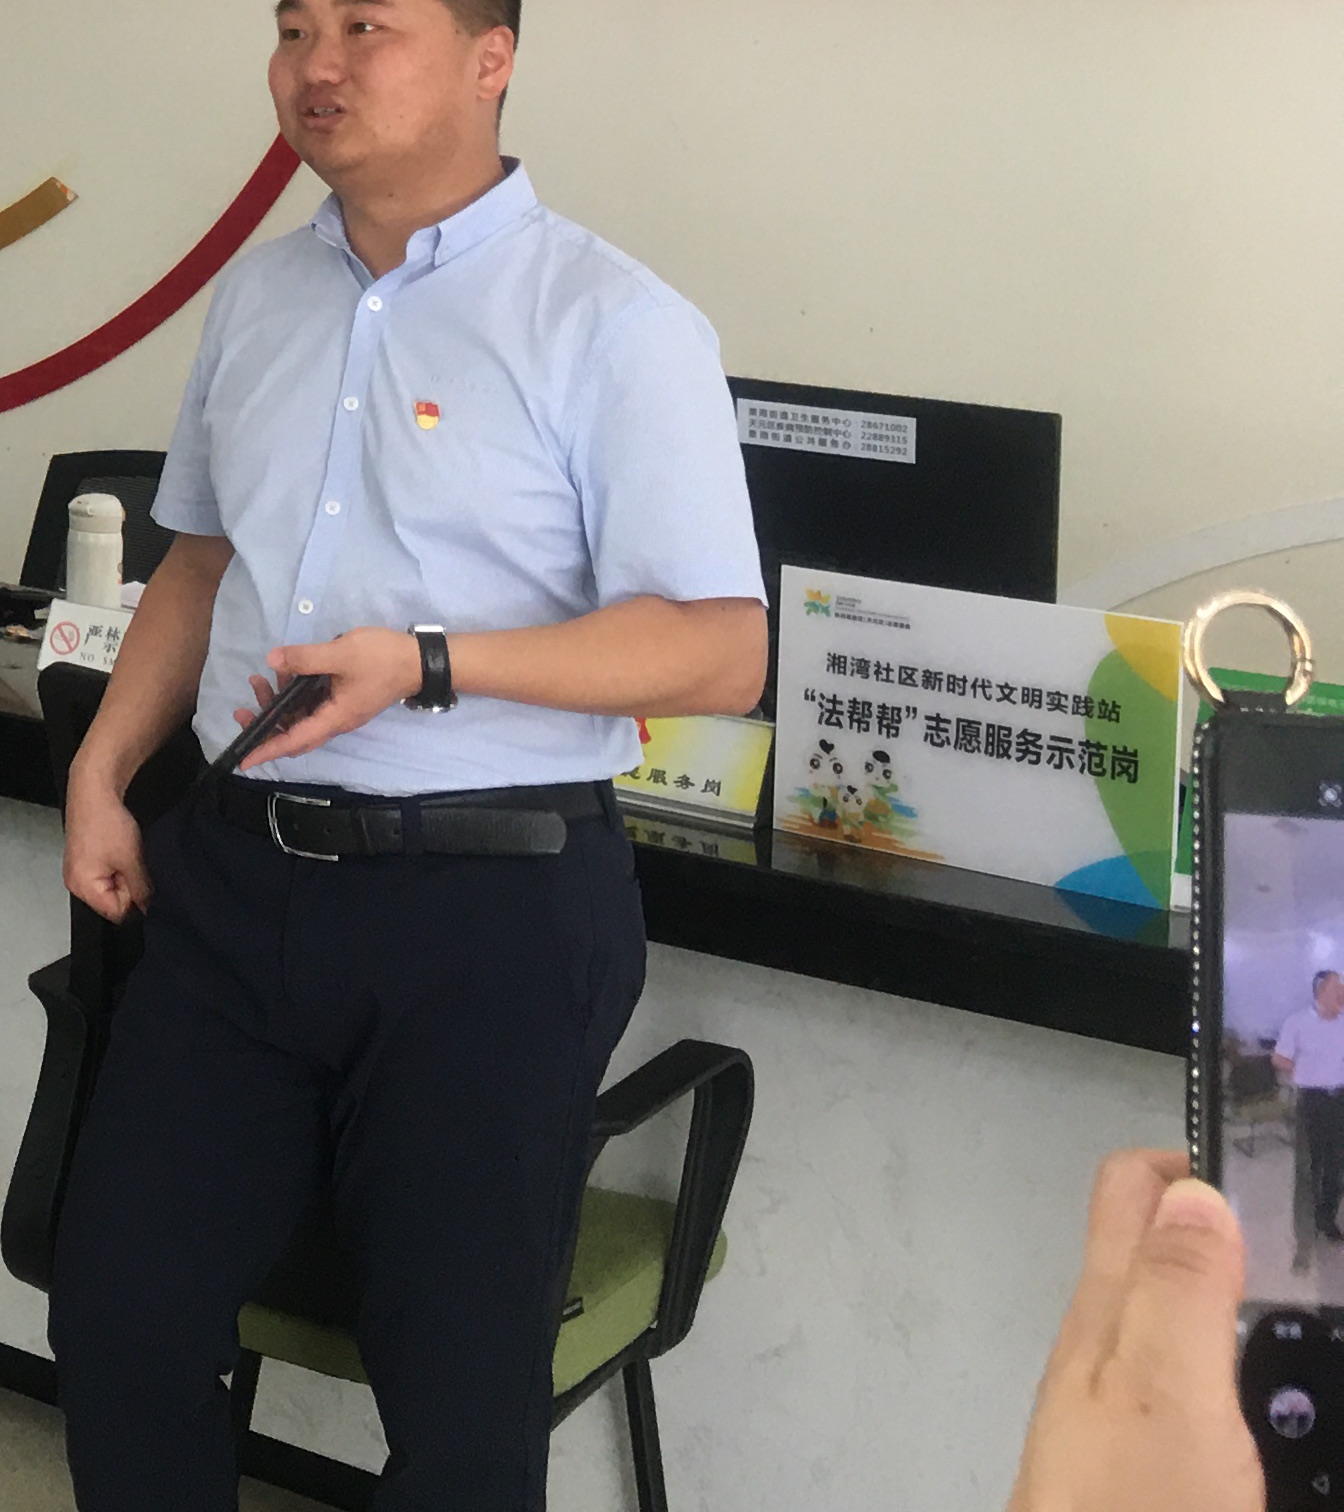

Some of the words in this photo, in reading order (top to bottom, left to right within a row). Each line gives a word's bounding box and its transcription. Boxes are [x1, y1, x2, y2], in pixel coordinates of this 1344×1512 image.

[79, 651, 95, 662] NO
[826, 652, 1122, 724] 湘湾社区新时代文明实践站
[804, 688, 1140, 784] “法帮帮”志愿服务示范岗
